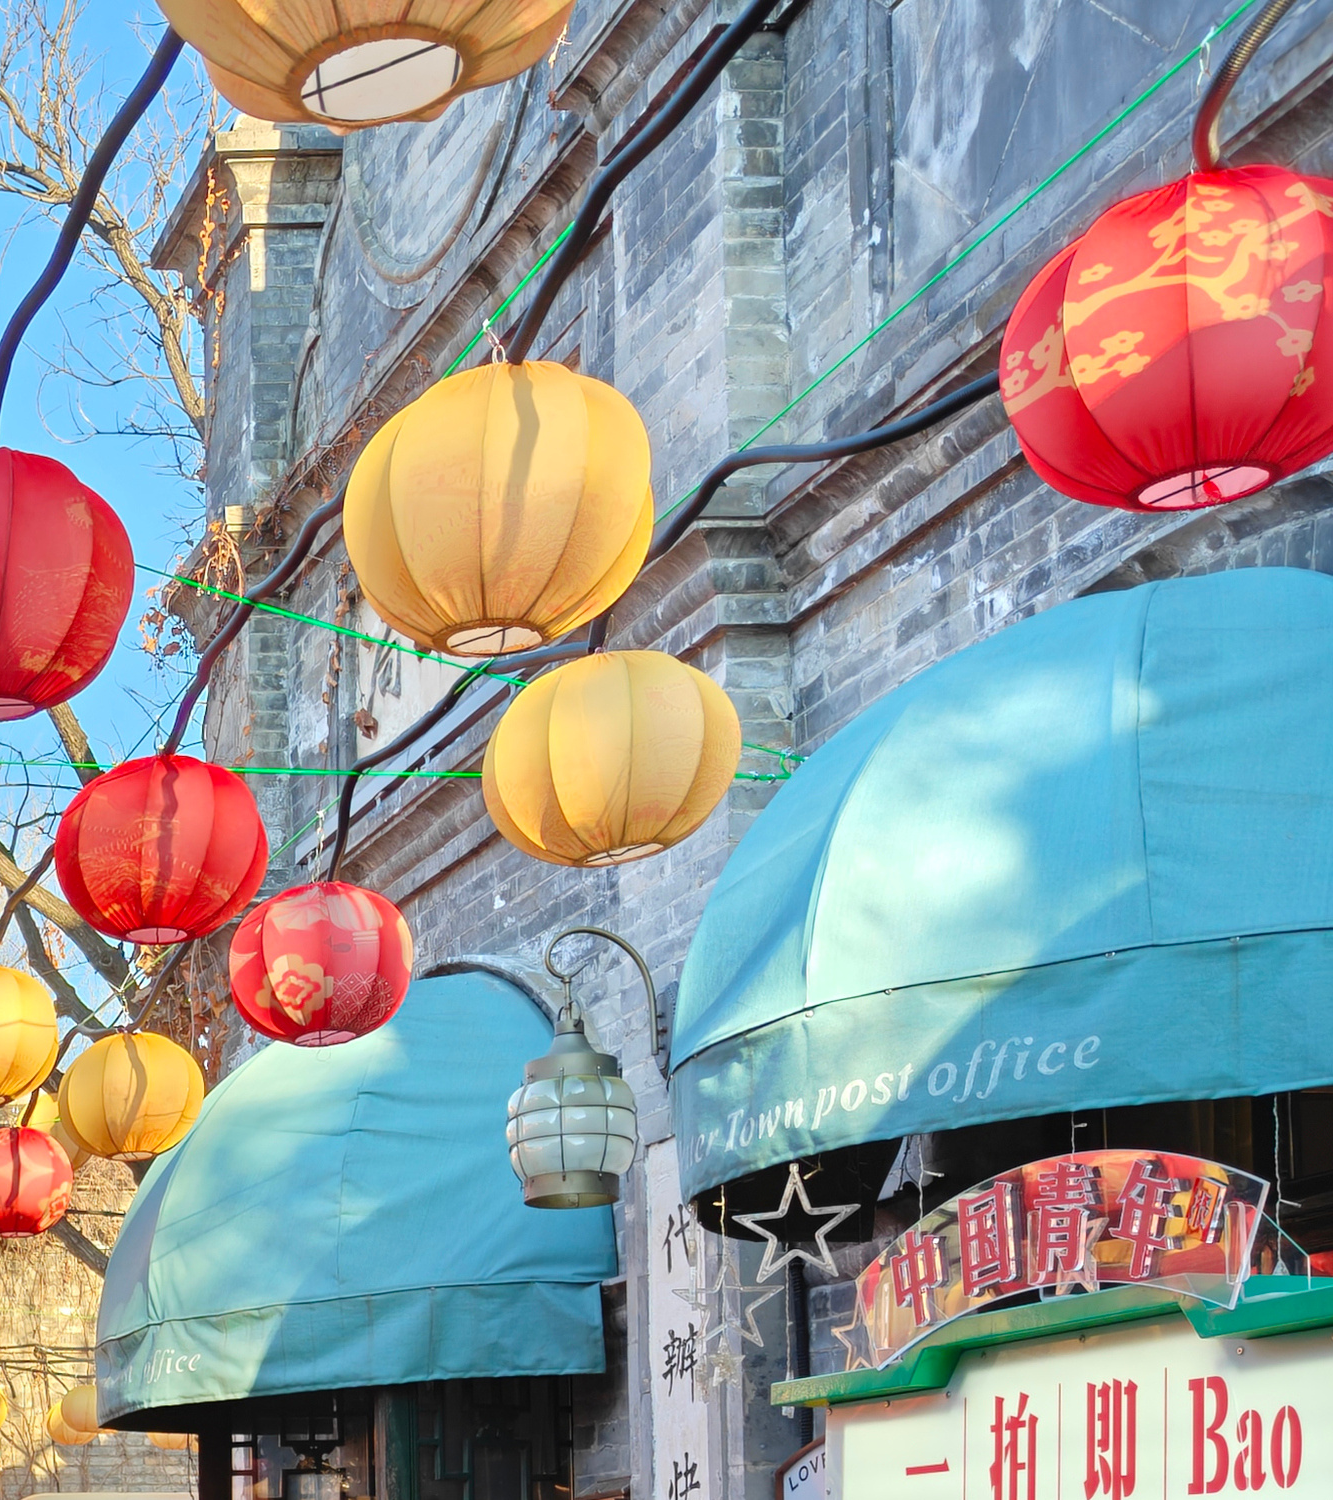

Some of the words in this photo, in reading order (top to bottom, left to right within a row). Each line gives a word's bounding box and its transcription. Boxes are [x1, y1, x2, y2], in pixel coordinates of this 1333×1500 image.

[724, 1096, 805, 1153] Town
[810, 1063, 915, 1131] post
[927, 1035, 1102, 1103] office
[144, 1349, 201, 1384] office
